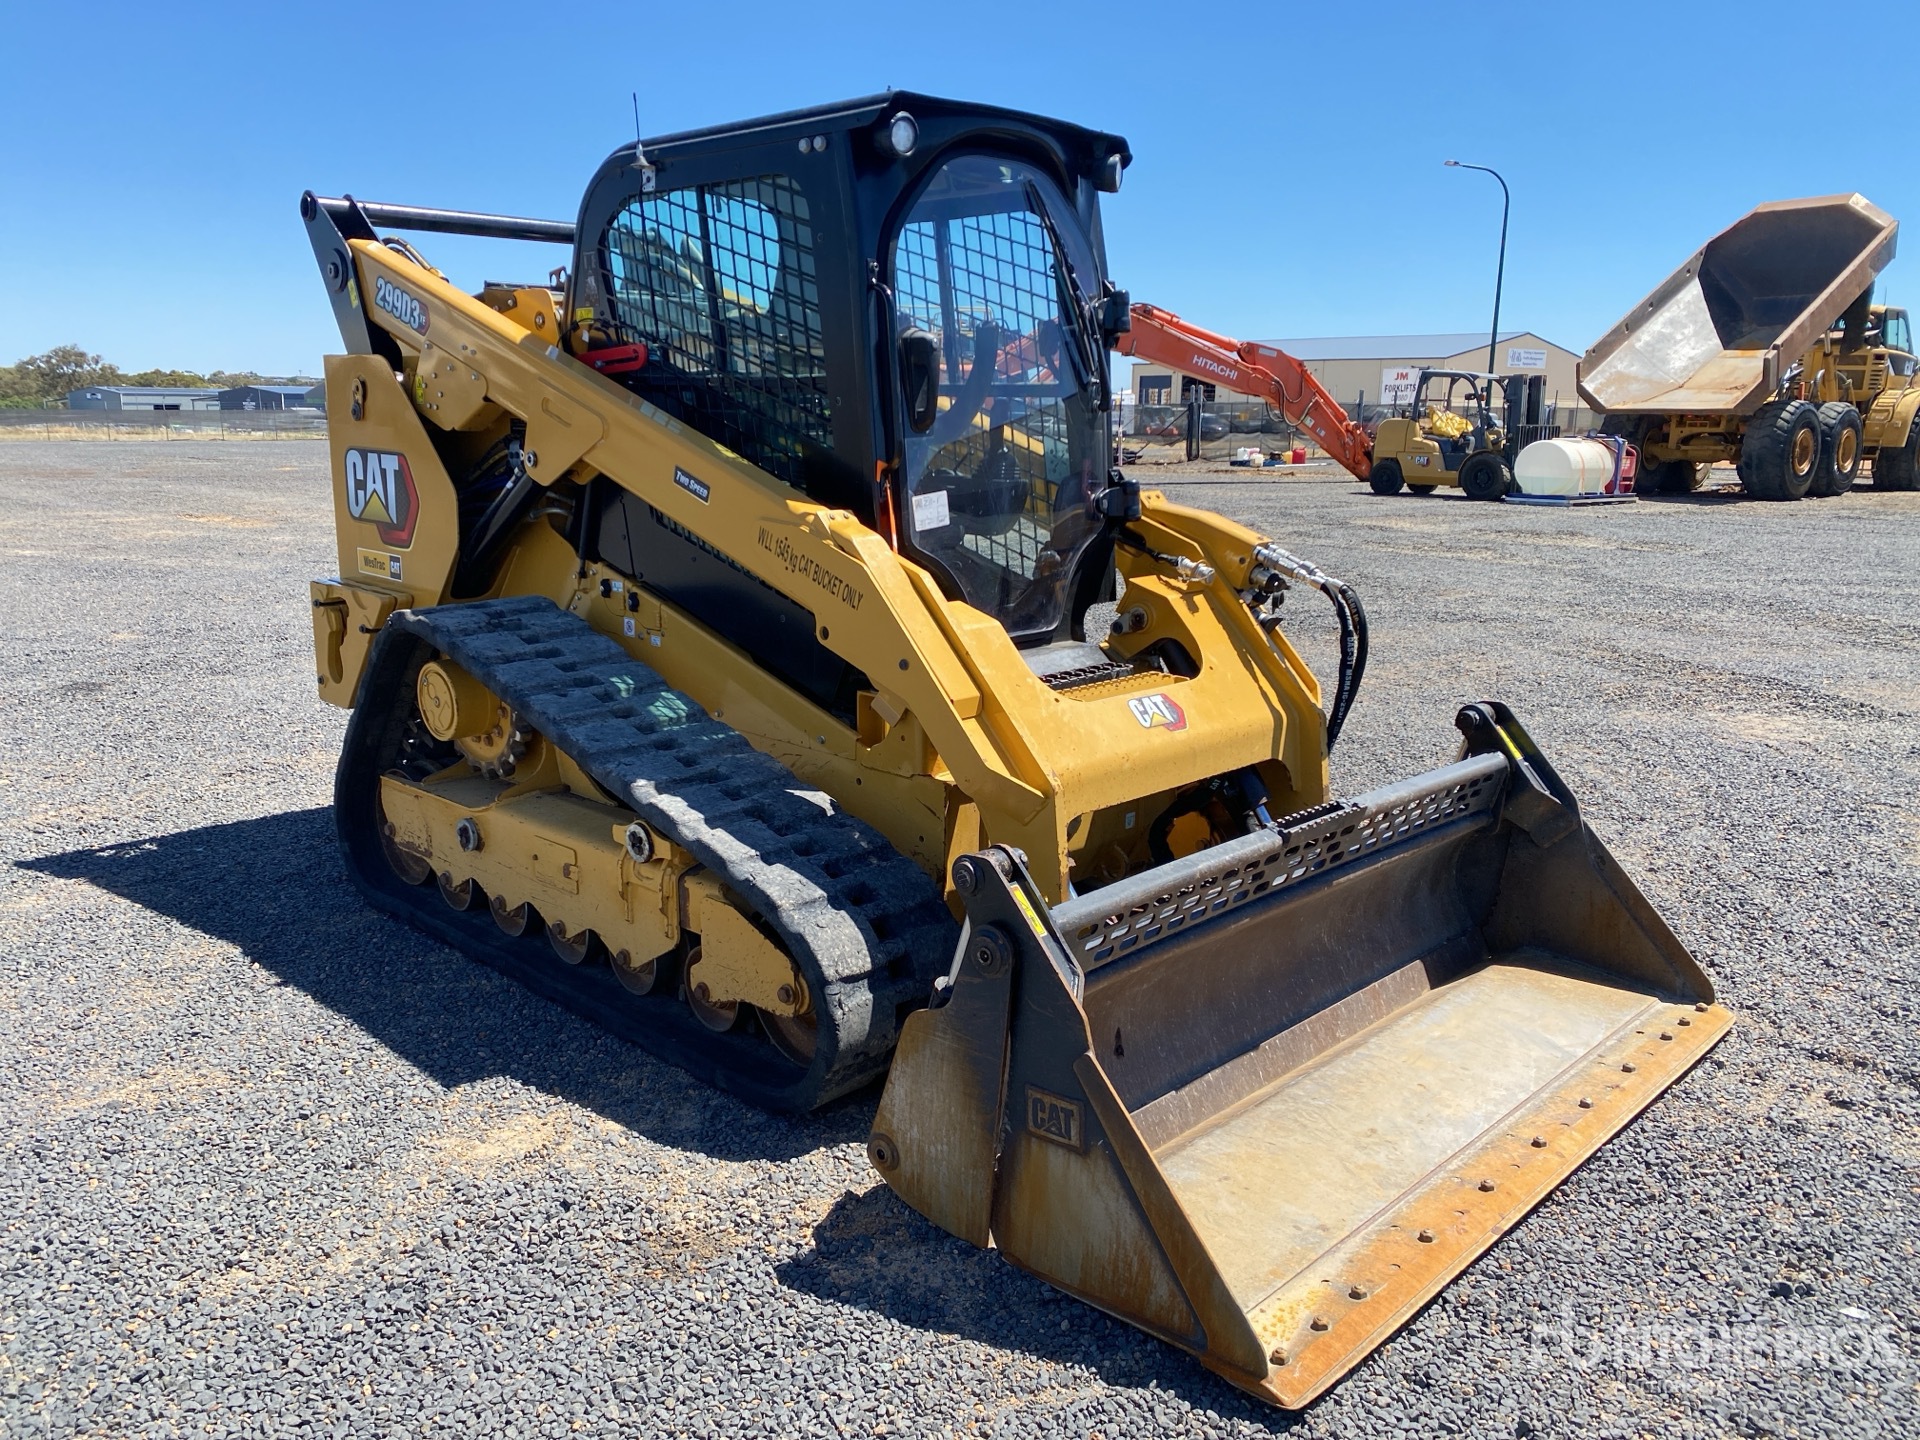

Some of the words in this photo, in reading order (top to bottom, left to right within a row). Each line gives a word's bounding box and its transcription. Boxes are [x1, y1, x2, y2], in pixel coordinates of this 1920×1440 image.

[375, 276, 420, 330] 299D3
[1192, 354, 1238, 380] HITACHI
[1395, 372, 1409, 381] JM
[1384, 384, 1417, 393] FORKLIFTS
[1415, 456, 1429, 466] CAT
[345, 449, 399, 525] CAT
[363, 555, 386, 571] WesTrac
[758, 526, 773, 552] WLL
[775, 537, 790, 562] 1545
[789, 547, 798, 573] kg
[798, 554, 814, 578] CAT
[812, 562, 844, 598] BUCKET
[842, 583, 864, 612] ONLY
[1127, 694, 1175, 728] CAT
[1031, 1096, 1075, 1142] CAT
